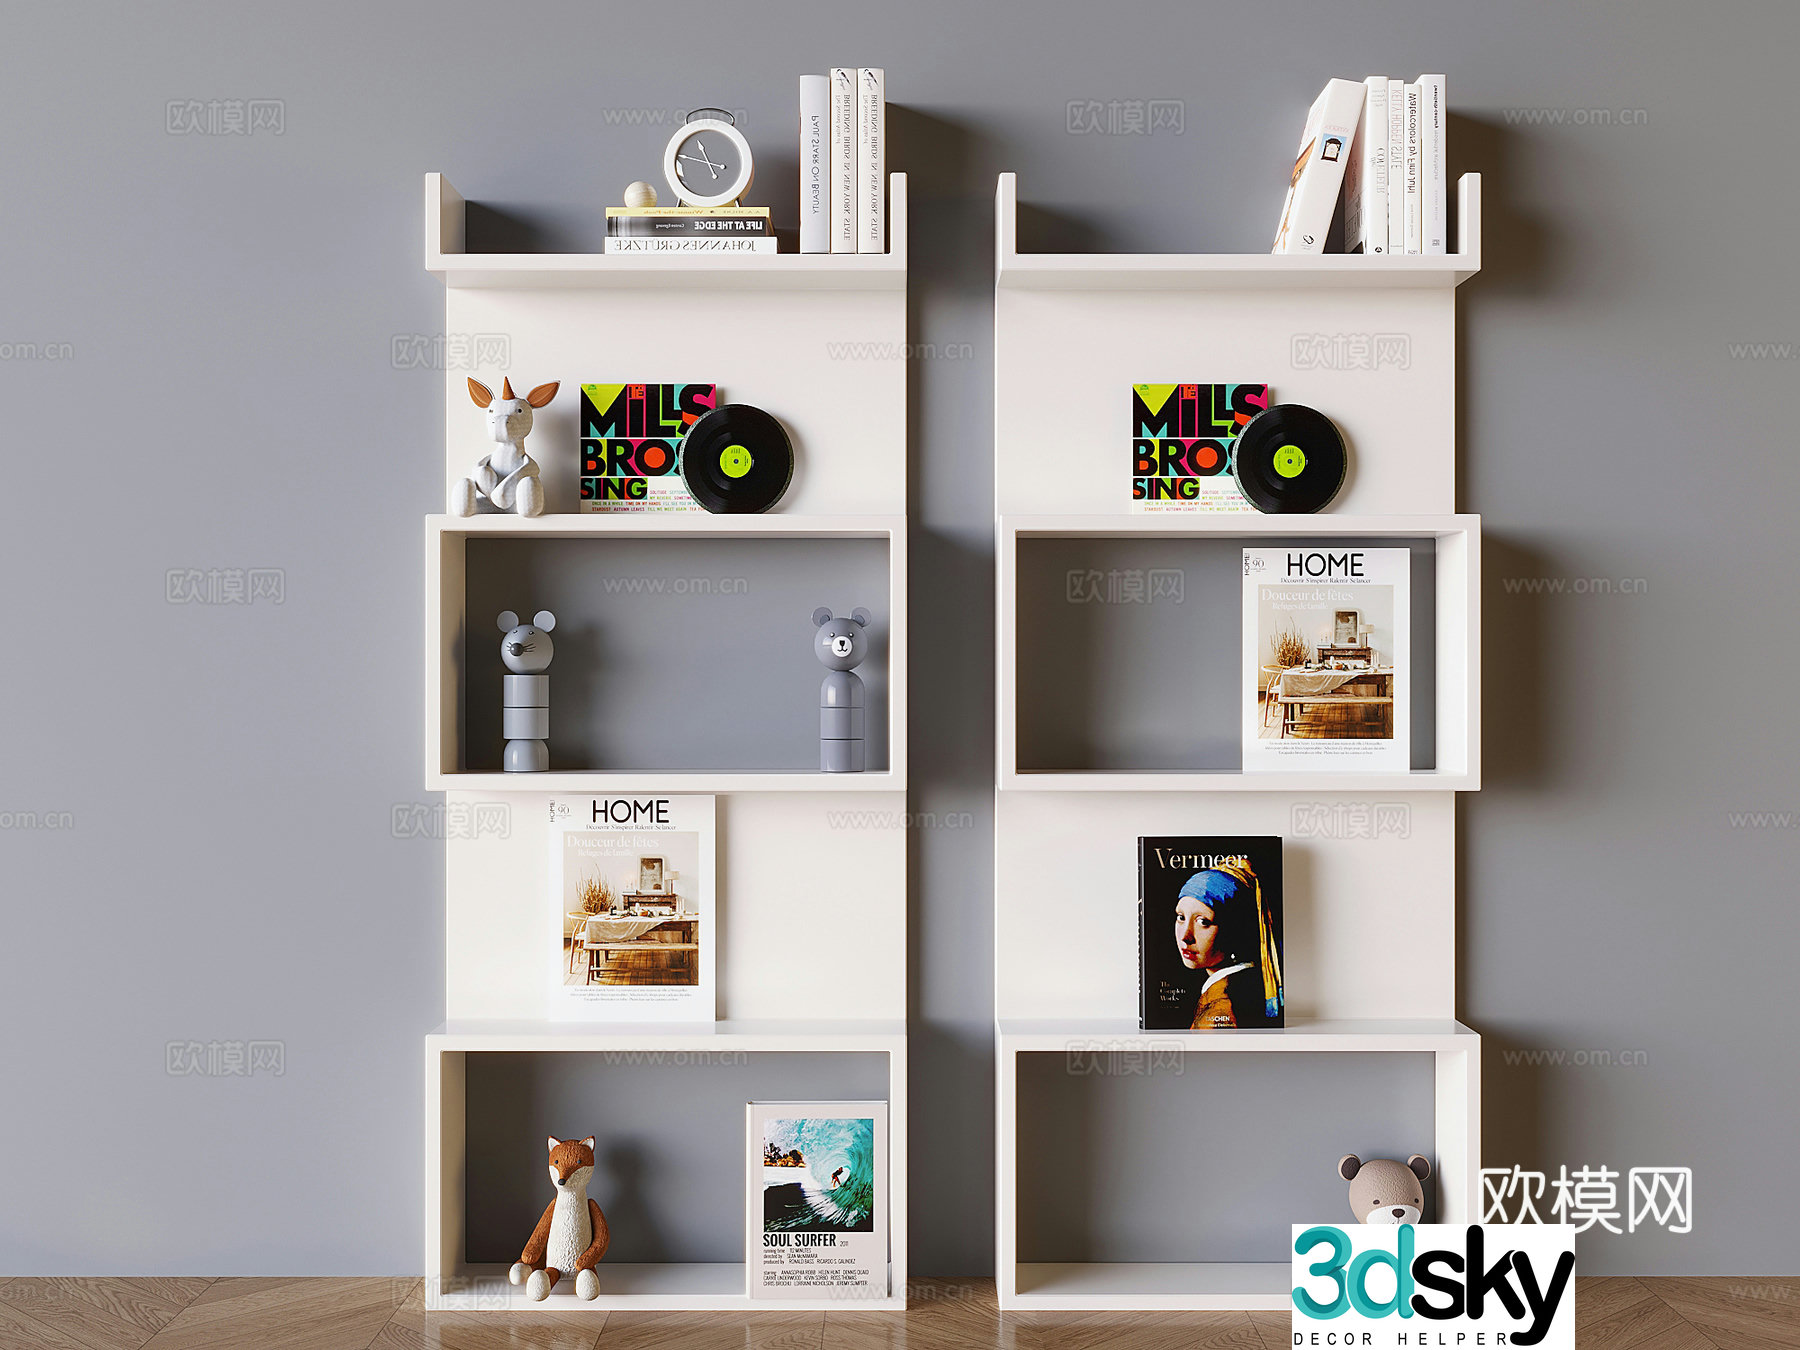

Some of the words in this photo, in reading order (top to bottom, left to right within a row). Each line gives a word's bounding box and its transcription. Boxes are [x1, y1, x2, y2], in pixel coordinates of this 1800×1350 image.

[581, 439, 684, 476] BRO
[1133, 439, 1236, 476] BRO
[581, 478, 648, 500] SING
[1133, 478, 1200, 500] SING
[1287, 553, 1364, 577] HOME
[1262, 588, 1310, 601] Douceur
[1312, 588, 1326, 601] de
[592, 800, 670, 823] HOME
[567, 835, 615, 848] Douceur
[617, 835, 631, 848] de
[1154, 848, 1248, 869] Vermeer
[763, 1234, 792, 1247] SOUL
[794, 1234, 836, 1247] SURFER
